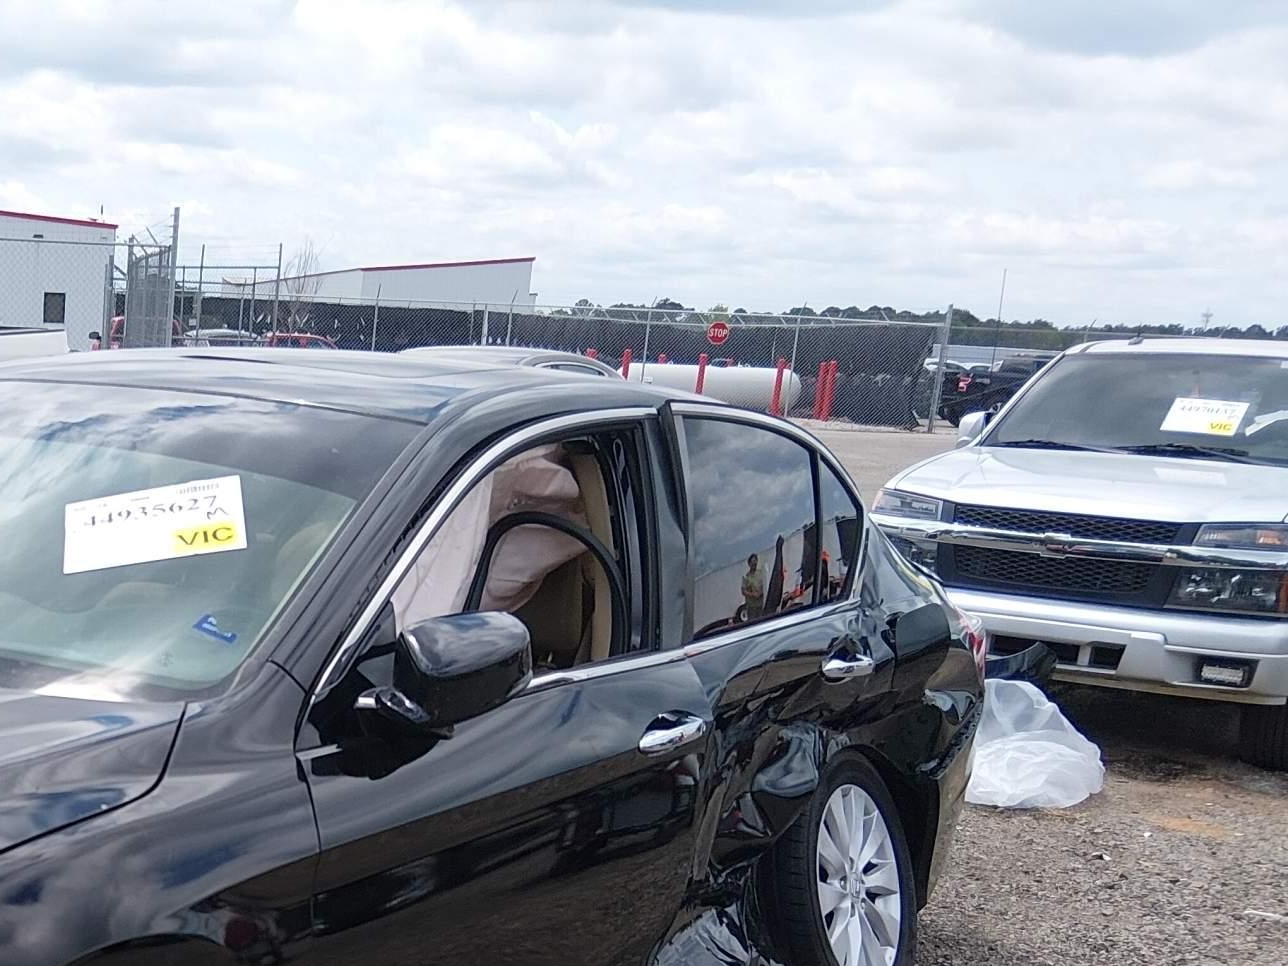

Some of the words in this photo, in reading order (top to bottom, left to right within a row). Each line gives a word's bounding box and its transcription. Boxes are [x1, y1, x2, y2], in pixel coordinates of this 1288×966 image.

[709, 329, 728, 338] STOP
[84, 495, 217, 526] 44935627
[177, 527, 234, 546] VIC
